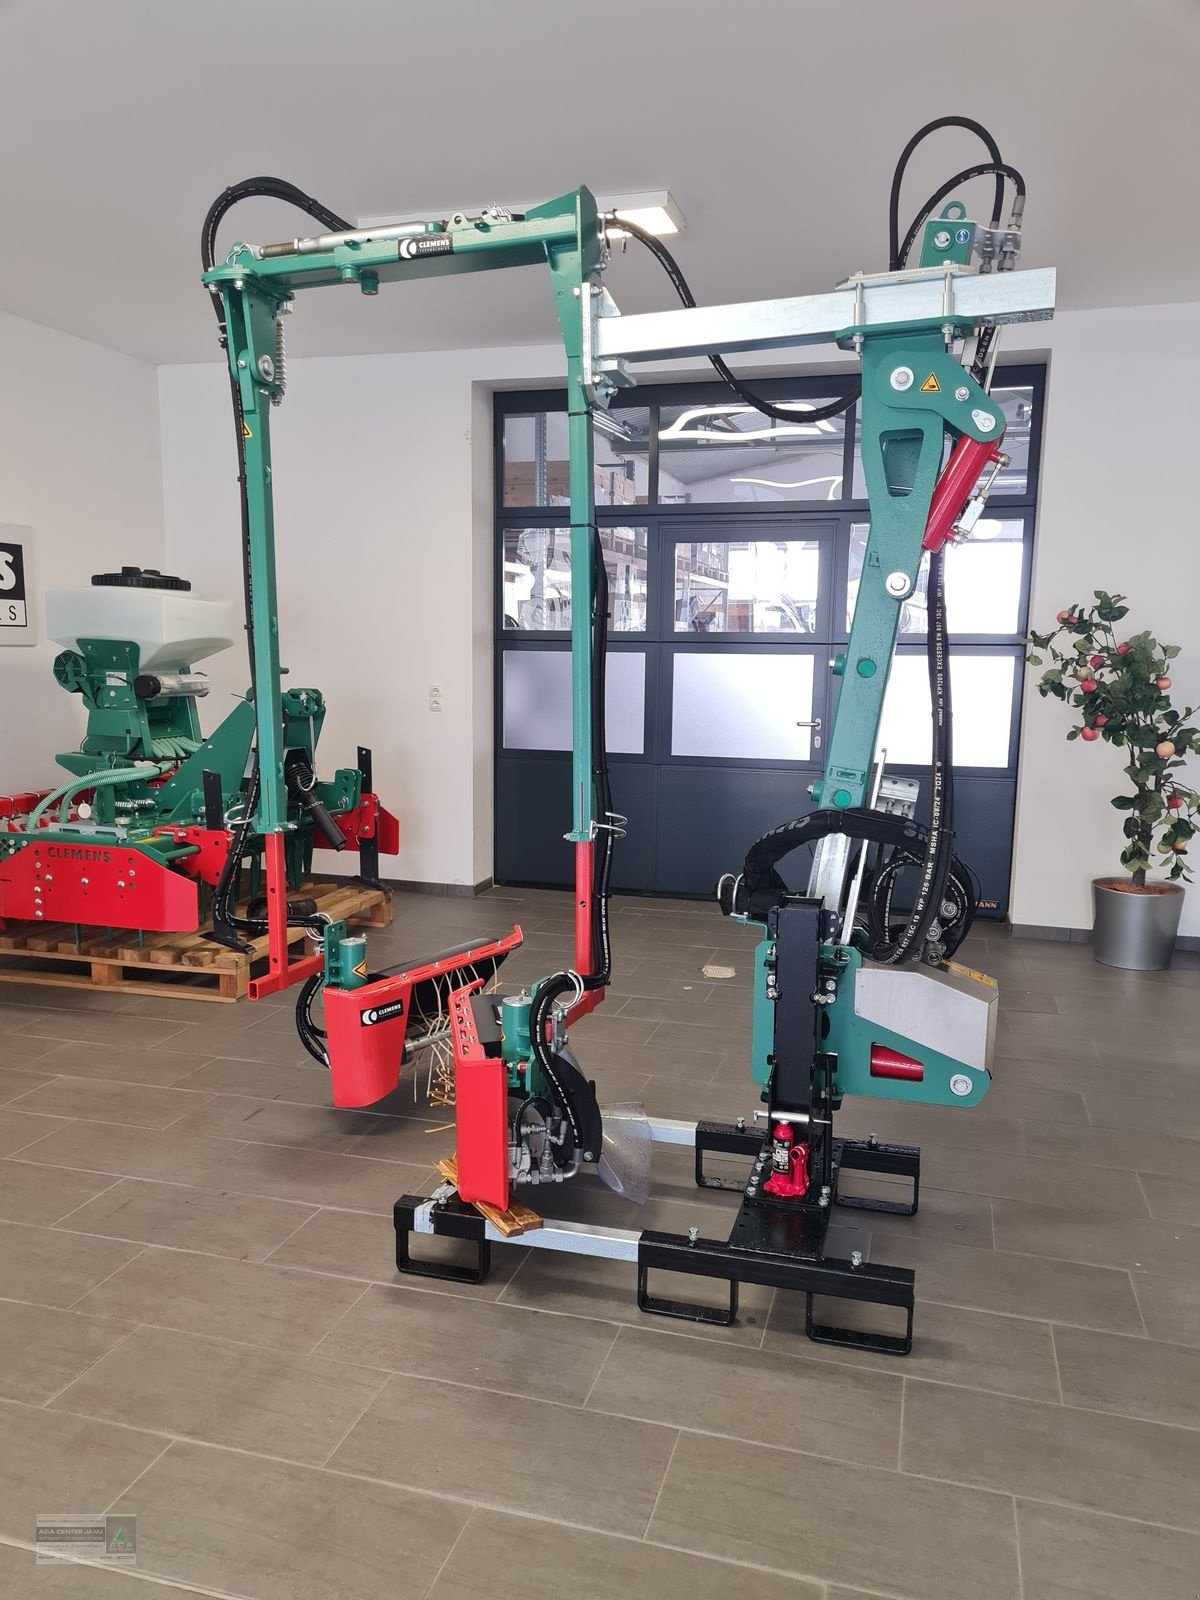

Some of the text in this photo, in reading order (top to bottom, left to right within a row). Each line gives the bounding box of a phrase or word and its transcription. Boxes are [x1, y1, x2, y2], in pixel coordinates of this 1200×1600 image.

[419, 240, 450, 248] CLEMENS
[936, 631, 942, 641] EN
[929, 830, 938, 855] MSHA
[48, 846, 112, 863] CLEMENS
[925, 862, 934, 880] BAR
[921, 882, 930, 896] 125
[916, 898, 925, 911] WP
[975, 901, 997, 909] ANN
[378, 1003, 401, 1015] CLEMENS
